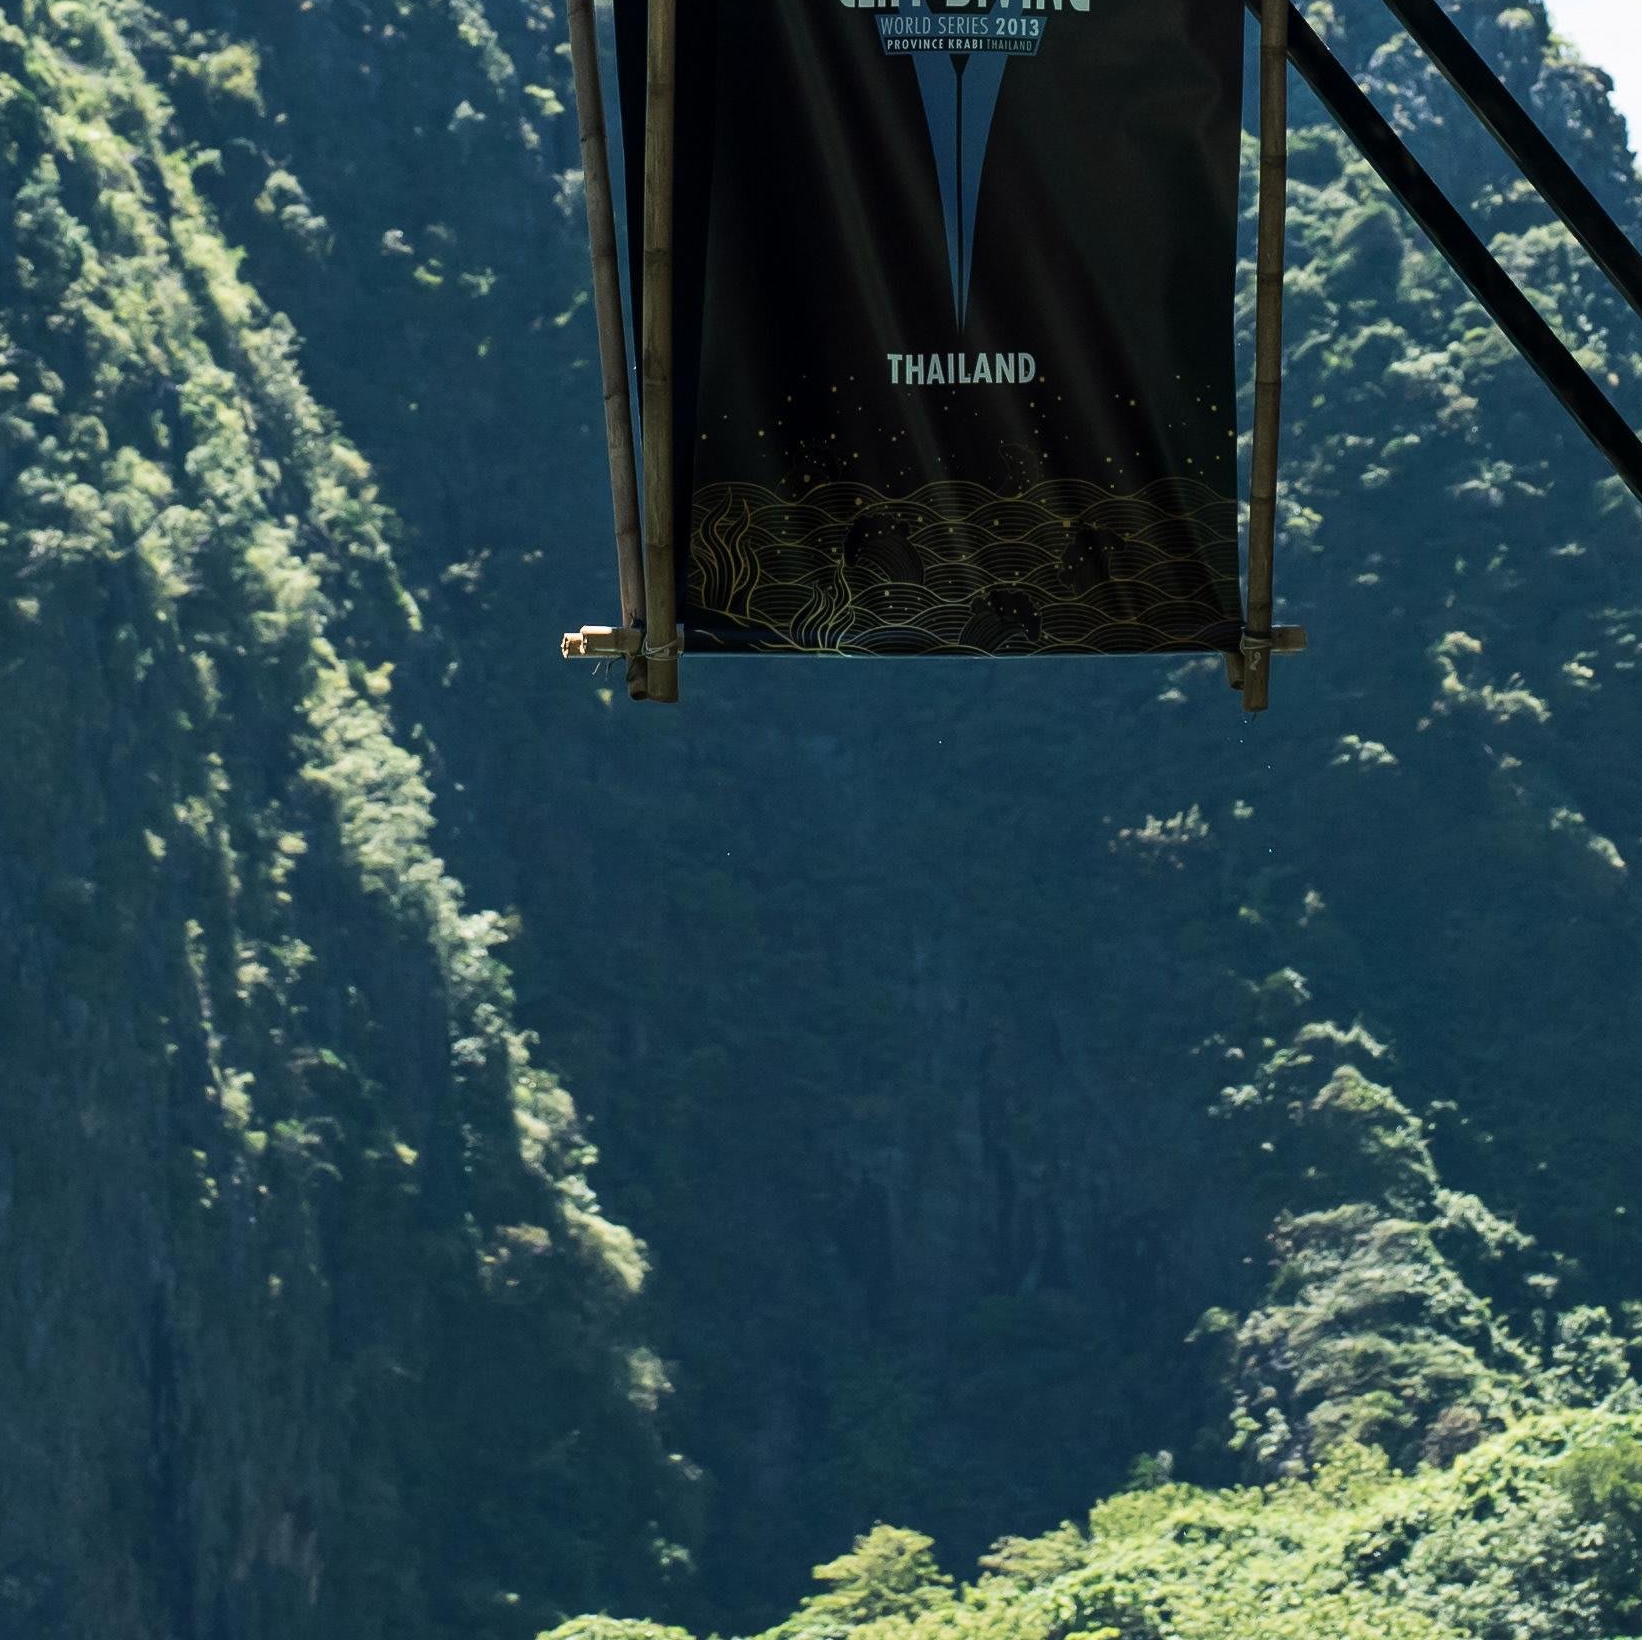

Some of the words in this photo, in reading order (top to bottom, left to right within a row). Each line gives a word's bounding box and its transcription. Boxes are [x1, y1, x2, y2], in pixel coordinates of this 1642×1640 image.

[880, 16, 931, 35] WORLD
[938, 16, 989, 35] SERIES
[995, 17, 1040, 37] 2013
[887, 38, 944, 50] PROVINCE
[948, 38, 983, 50] KRABI
[986, 39, 1032, 51] THAILAND
[887, 352, 1036, 385] THAILAND
